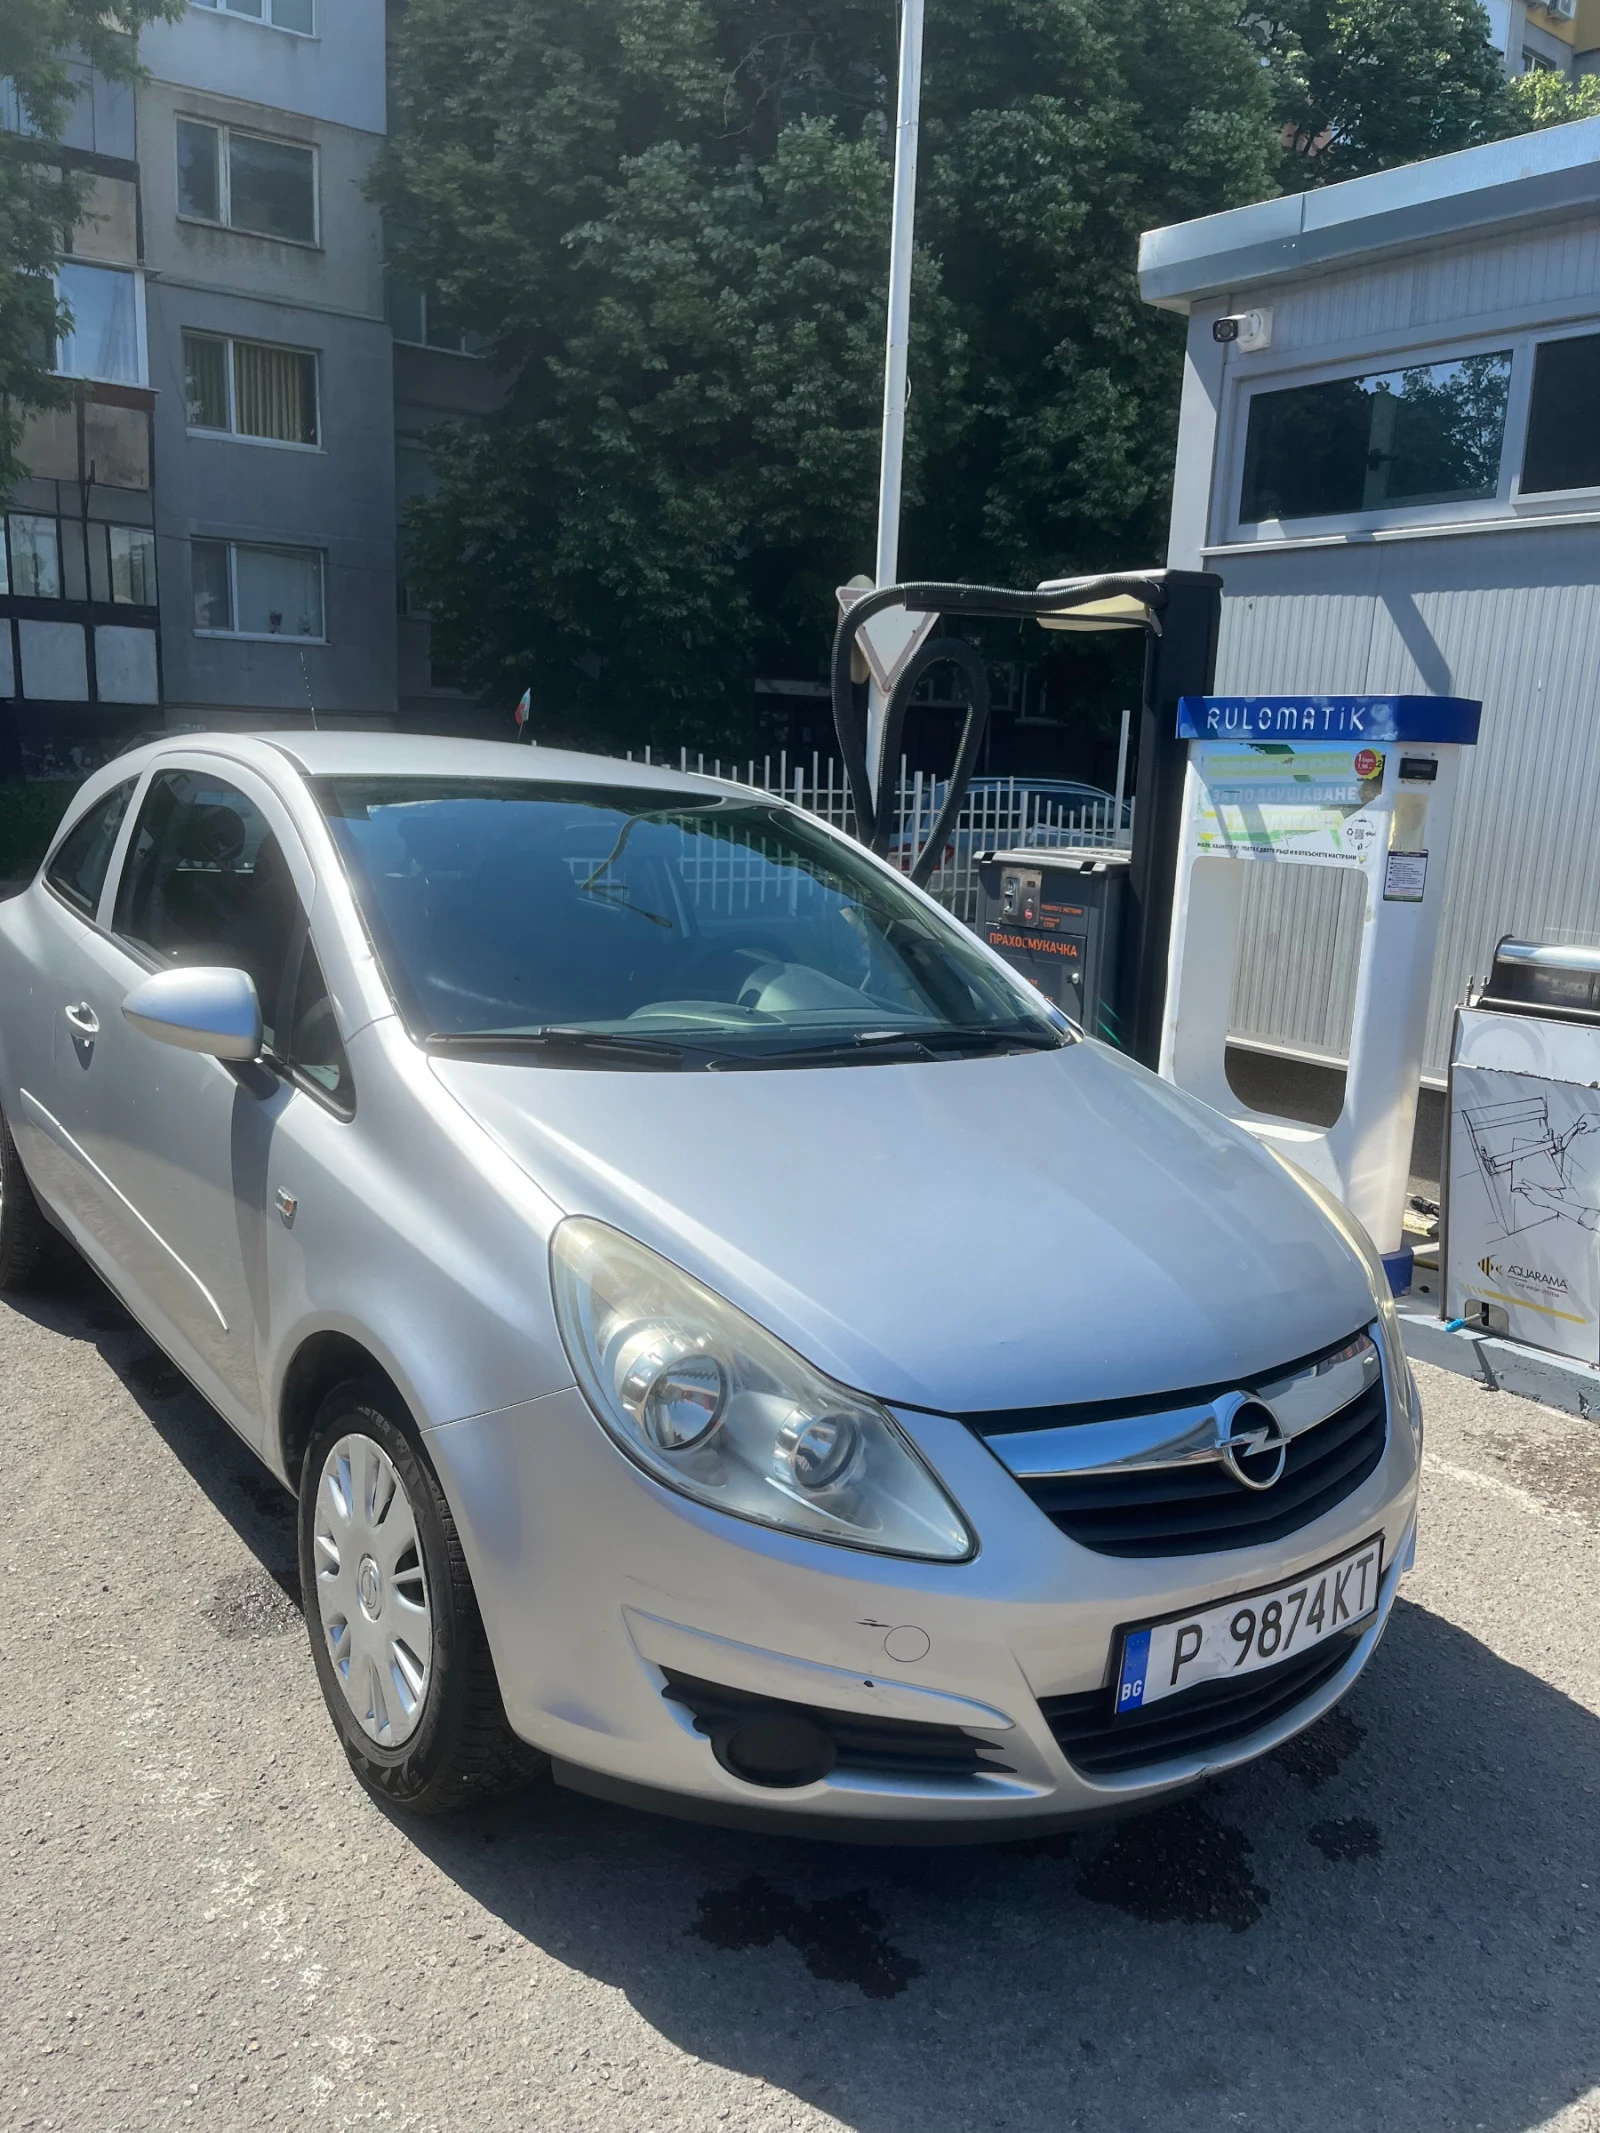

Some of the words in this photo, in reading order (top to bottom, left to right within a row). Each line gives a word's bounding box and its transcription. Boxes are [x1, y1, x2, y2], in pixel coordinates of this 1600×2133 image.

[989, 932, 1078, 957] ПРАХОСМУКАЧКА
[1507, 1265, 1568, 1290] AQUARAMA
[1169, 1624, 1203, 1686] P
[1121, 1679, 1143, 1702] BG
